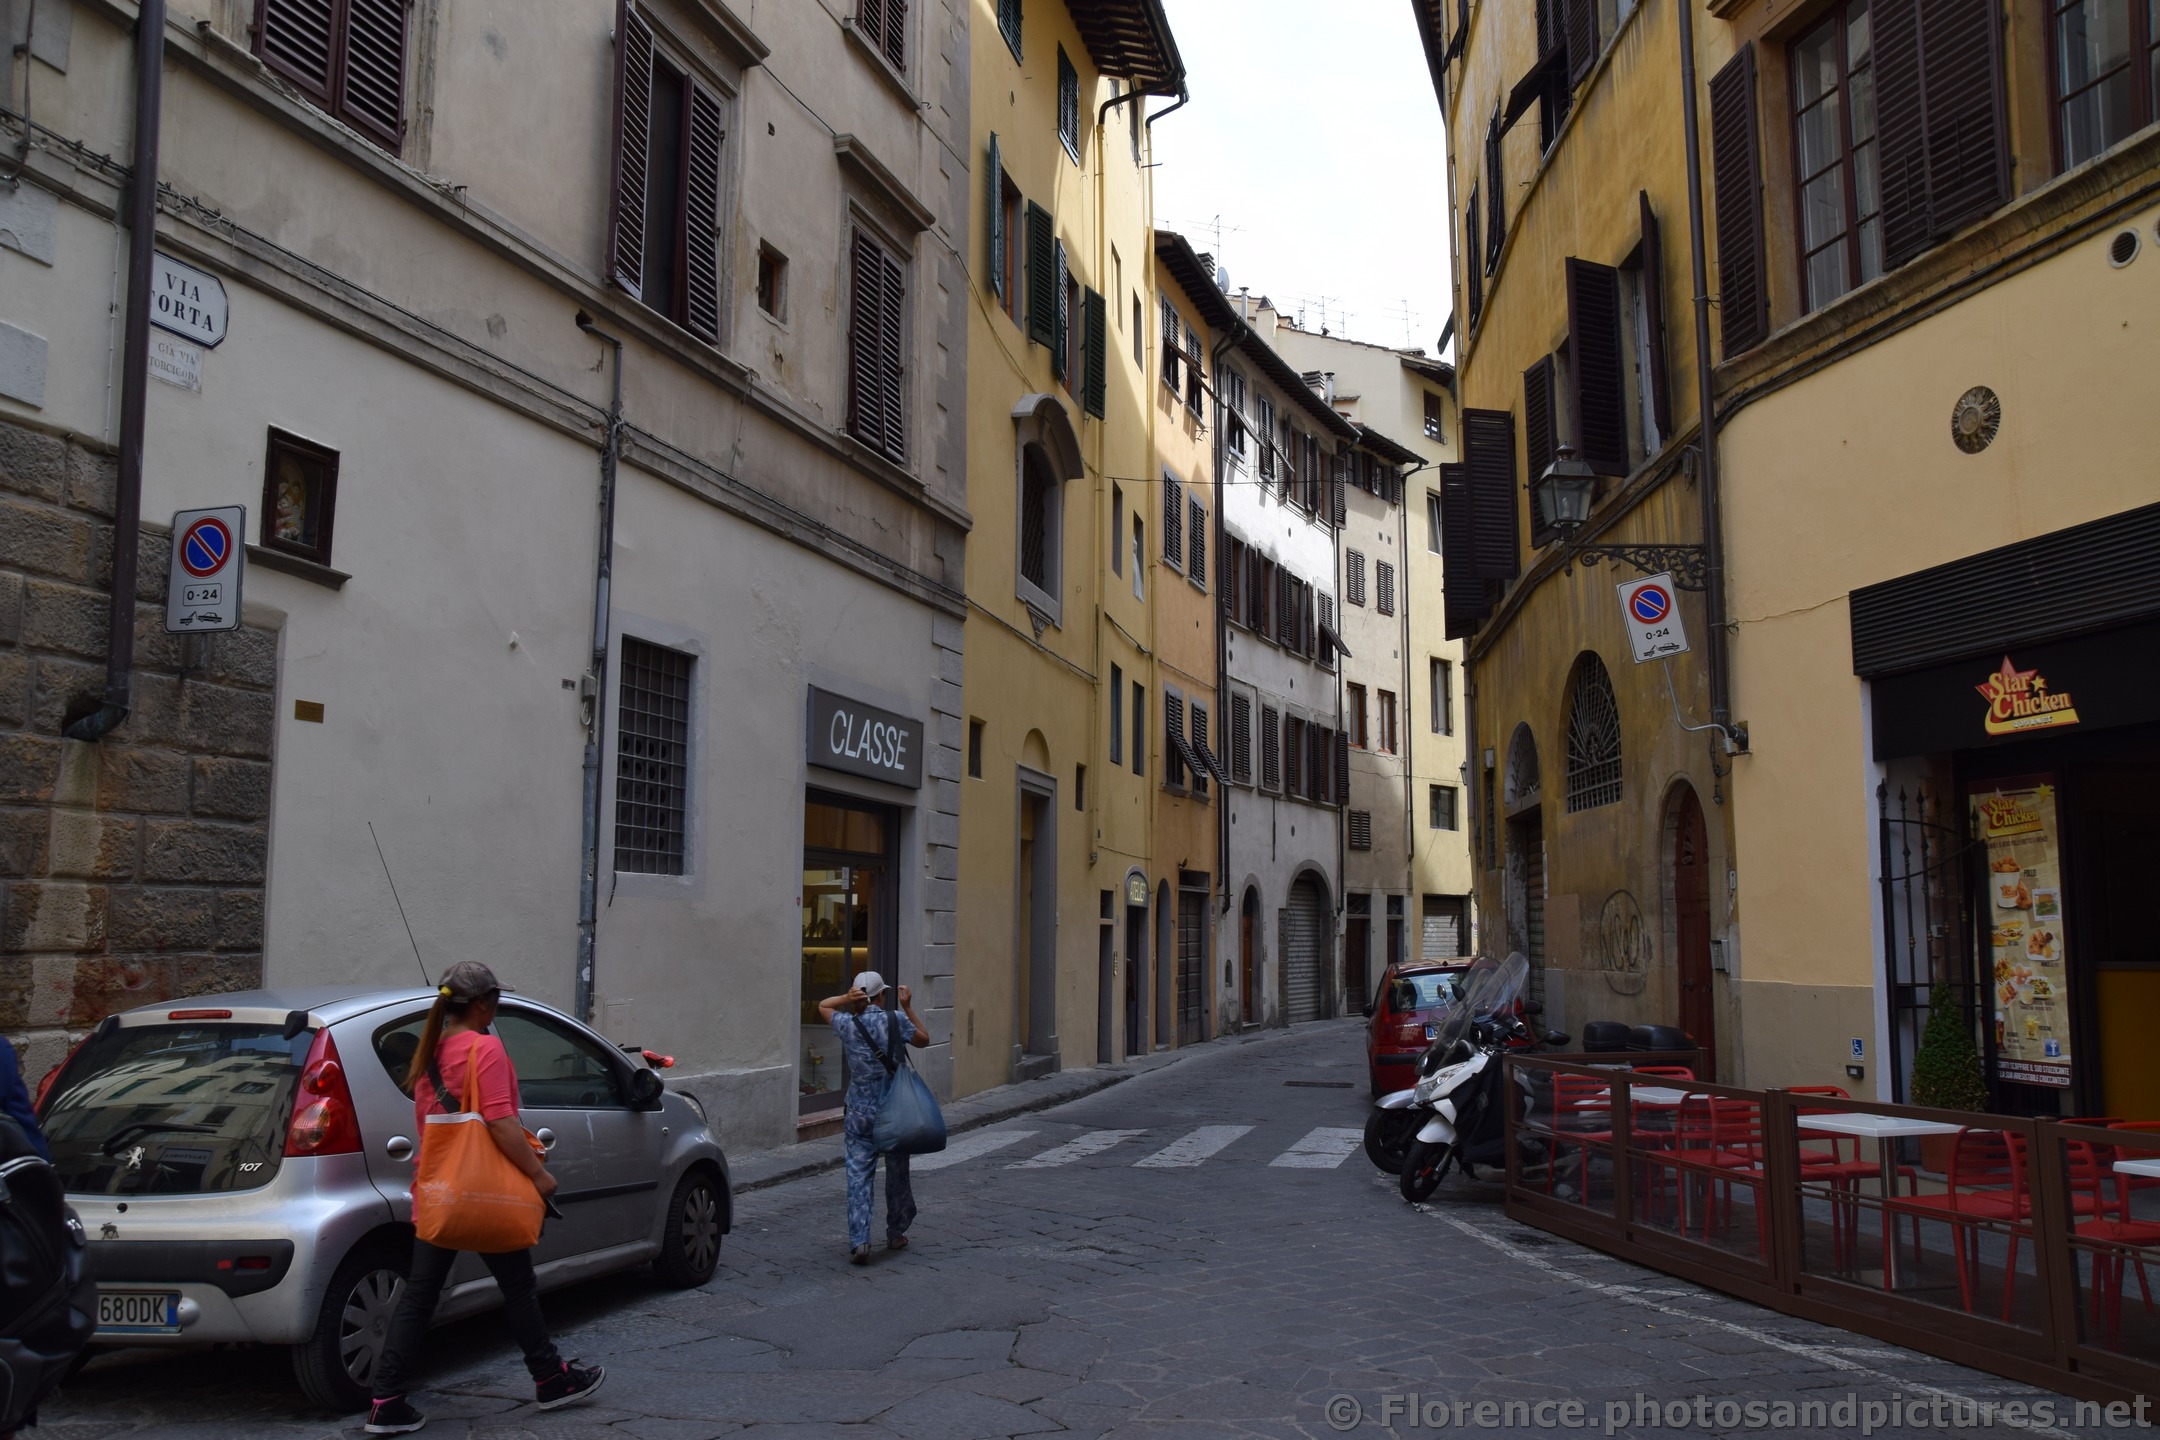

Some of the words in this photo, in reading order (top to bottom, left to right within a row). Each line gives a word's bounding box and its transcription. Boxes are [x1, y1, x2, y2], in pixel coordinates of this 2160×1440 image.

[165, 272, 201, 303] VIA
[151, 290, 214, 333] ORTA
[180, 350, 196, 366] VIA
[1645, 628, 1670, 640] 0-24
[1988, 672, 2030, 699] Star
[1992, 690, 2073, 719] Chicken
[830, 709, 909, 771] CLASSE
[1988, 797, 2014, 812] Star
[1992, 808, 2040, 827] Chicken
[239, 1162, 264, 1172] 107
[100, 1297, 164, 1323] 680DK
